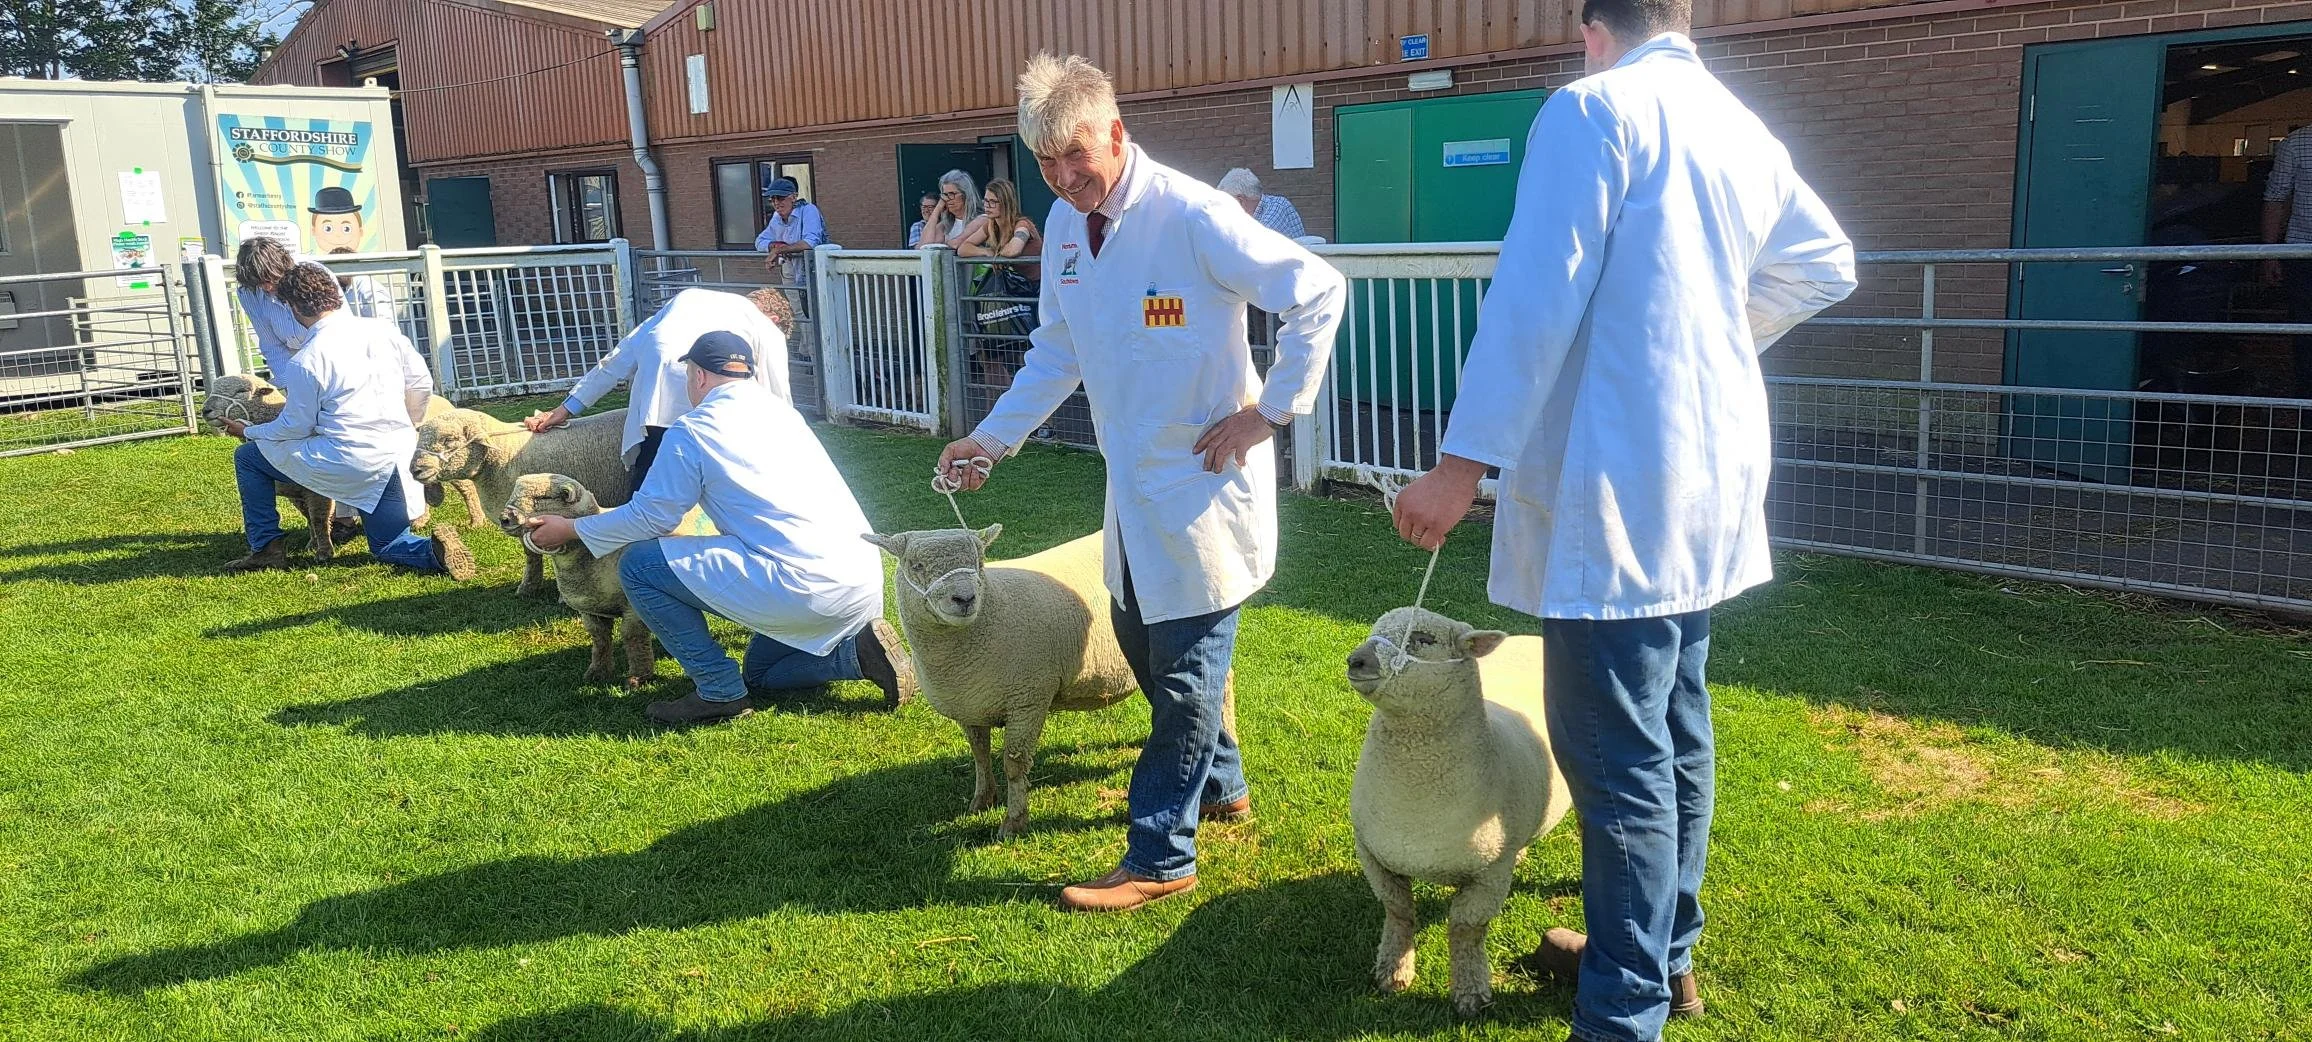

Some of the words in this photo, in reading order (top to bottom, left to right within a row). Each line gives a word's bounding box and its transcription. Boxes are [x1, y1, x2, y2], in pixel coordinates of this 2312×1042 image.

[1407, 37, 1426, 45] CLEAR
[1410, 47, 1425, 56] EXIT
[231, 127, 357, 145] STAFFORDSHIRE
[259, 142, 317, 154] COUNTY
[318, 145, 356, 156] SHOW
[1462, 153, 1480, 163] Keep
[1481, 153, 1500, 161] clear
